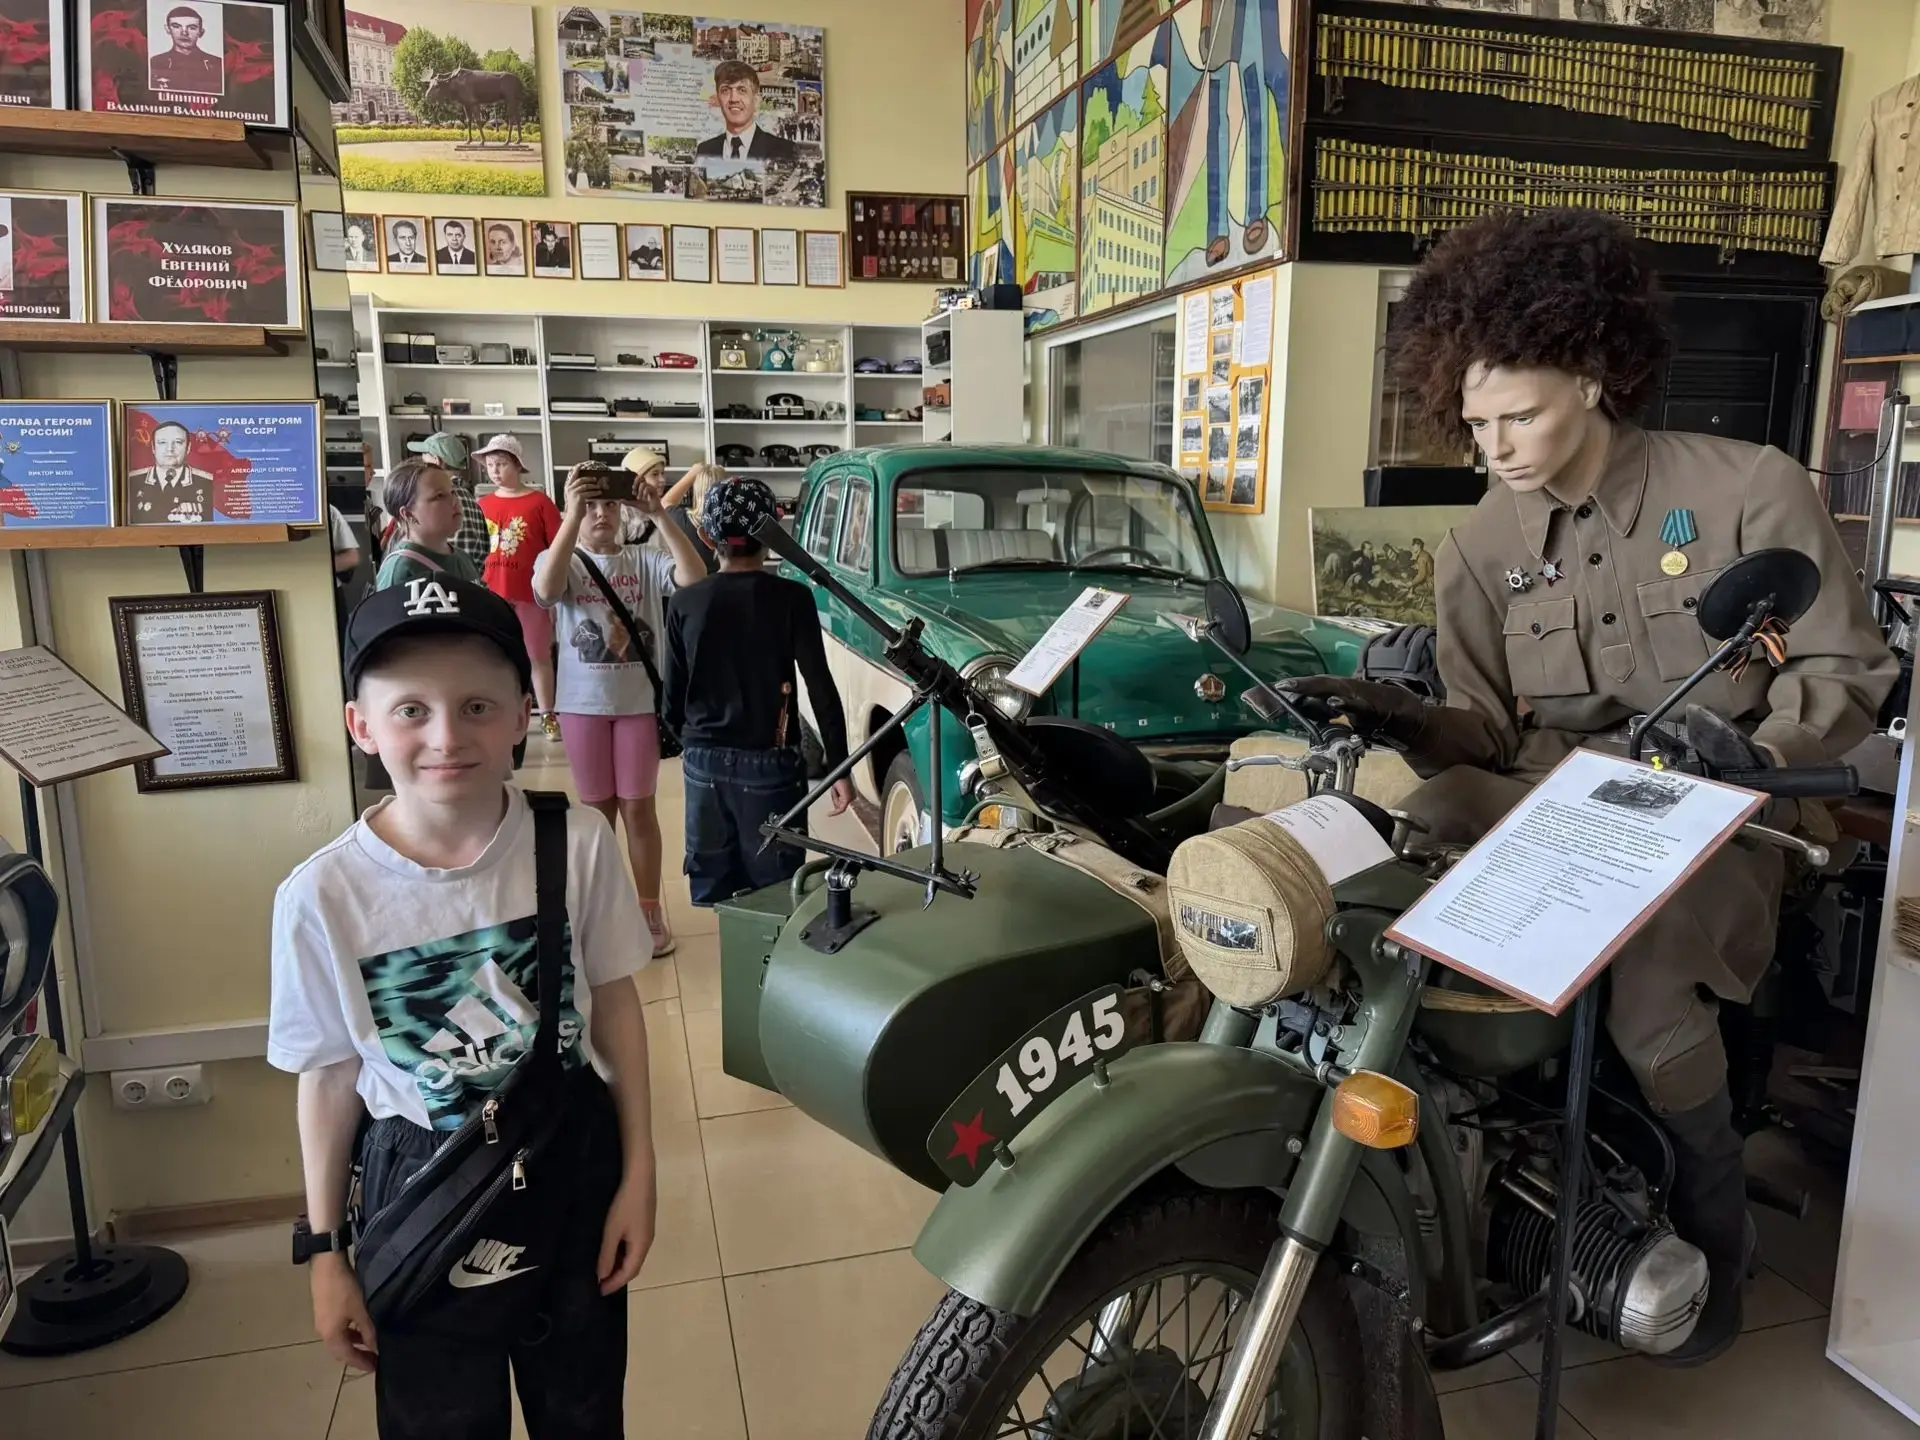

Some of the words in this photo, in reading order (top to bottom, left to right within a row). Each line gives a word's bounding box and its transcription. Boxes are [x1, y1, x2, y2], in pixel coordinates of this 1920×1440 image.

[1, 417, 42, 427] СЛАВА
[44, 417, 93, 427] ГЕРОЯМ
[218, 417, 256, 426] СЛАВА
[257, 416, 303, 425] ГЕРОЯМ
[20, 427, 74, 437] РОССИИ!
[244, 426, 277, 436] СССР!
[403, 577, 461, 616] LA
[996, 992, 1126, 1118] 1945
[462, 1238, 527, 1275] NIKE
